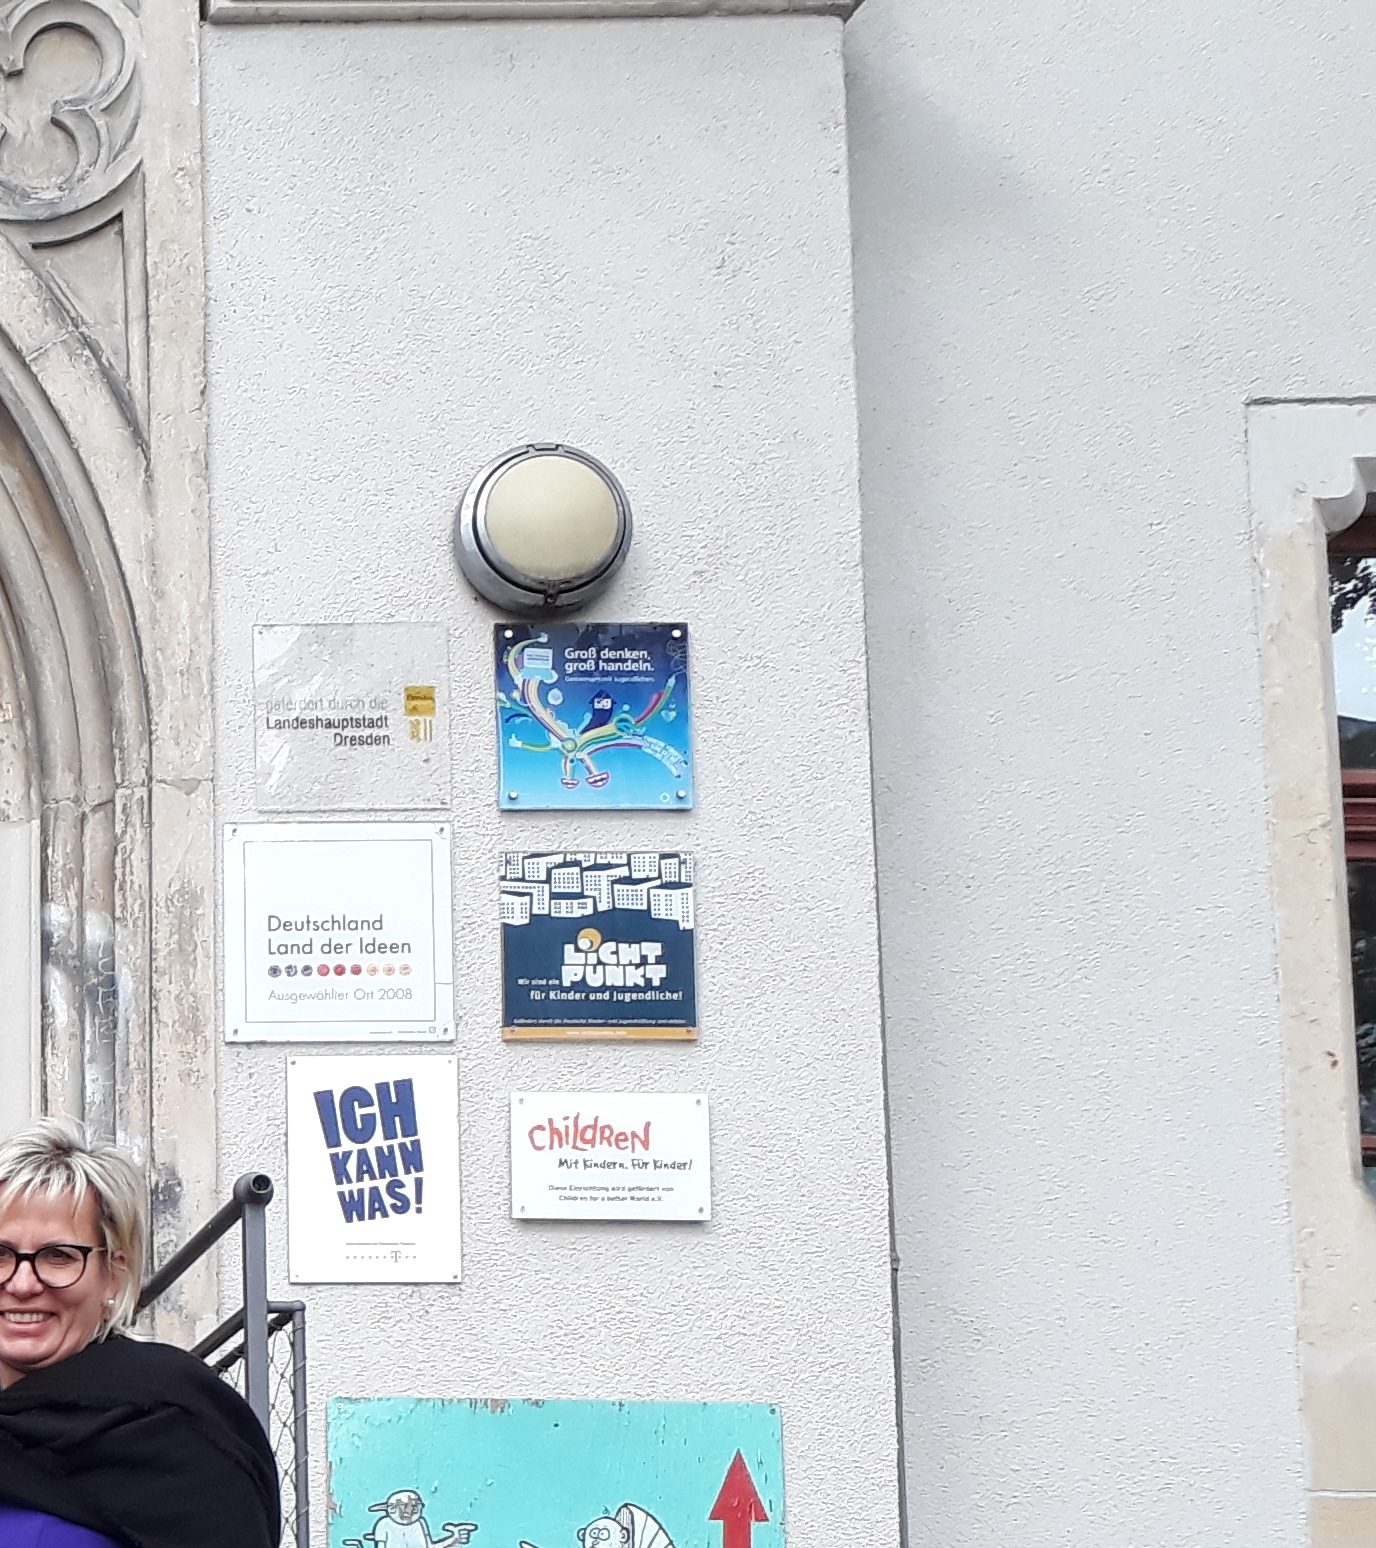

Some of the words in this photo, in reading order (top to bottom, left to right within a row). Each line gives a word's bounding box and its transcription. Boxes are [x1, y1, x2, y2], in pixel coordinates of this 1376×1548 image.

[564, 646, 597, 660] Groß
[600, 647, 651, 660] denken,
[564, 659, 596, 674] groß
[599, 660, 655, 672] handeln.
[368, 697, 389, 711] die
[266, 715, 389, 731] Landeshauptstadt
[333, 732, 391, 746] Dresden
[267, 914, 383, 932] Deutschland
[268, 937, 313, 955] Land
[320, 937, 353, 954] der
[359, 937, 412, 954] Ideen
[561, 964, 667, 988] PUNKT
[268, 987, 349, 1004] Ausgewählter
[353, 988, 374, 1000] Ort
[377, 987, 413, 1000] 2008
[530, 989, 547, 1000] für
[549, 989, 587, 1000] Kinder
[589, 989, 610, 1000] und
[313, 1078, 419, 1149] ICH
[329, 1138, 424, 1186] KANN
[558, 1157, 580, 1170] Mit
[582, 1158, 629, 1170] Kindern.
[652, 1158, 693, 1170] Kinder!
[336, 1176, 424, 1224] WAS!
